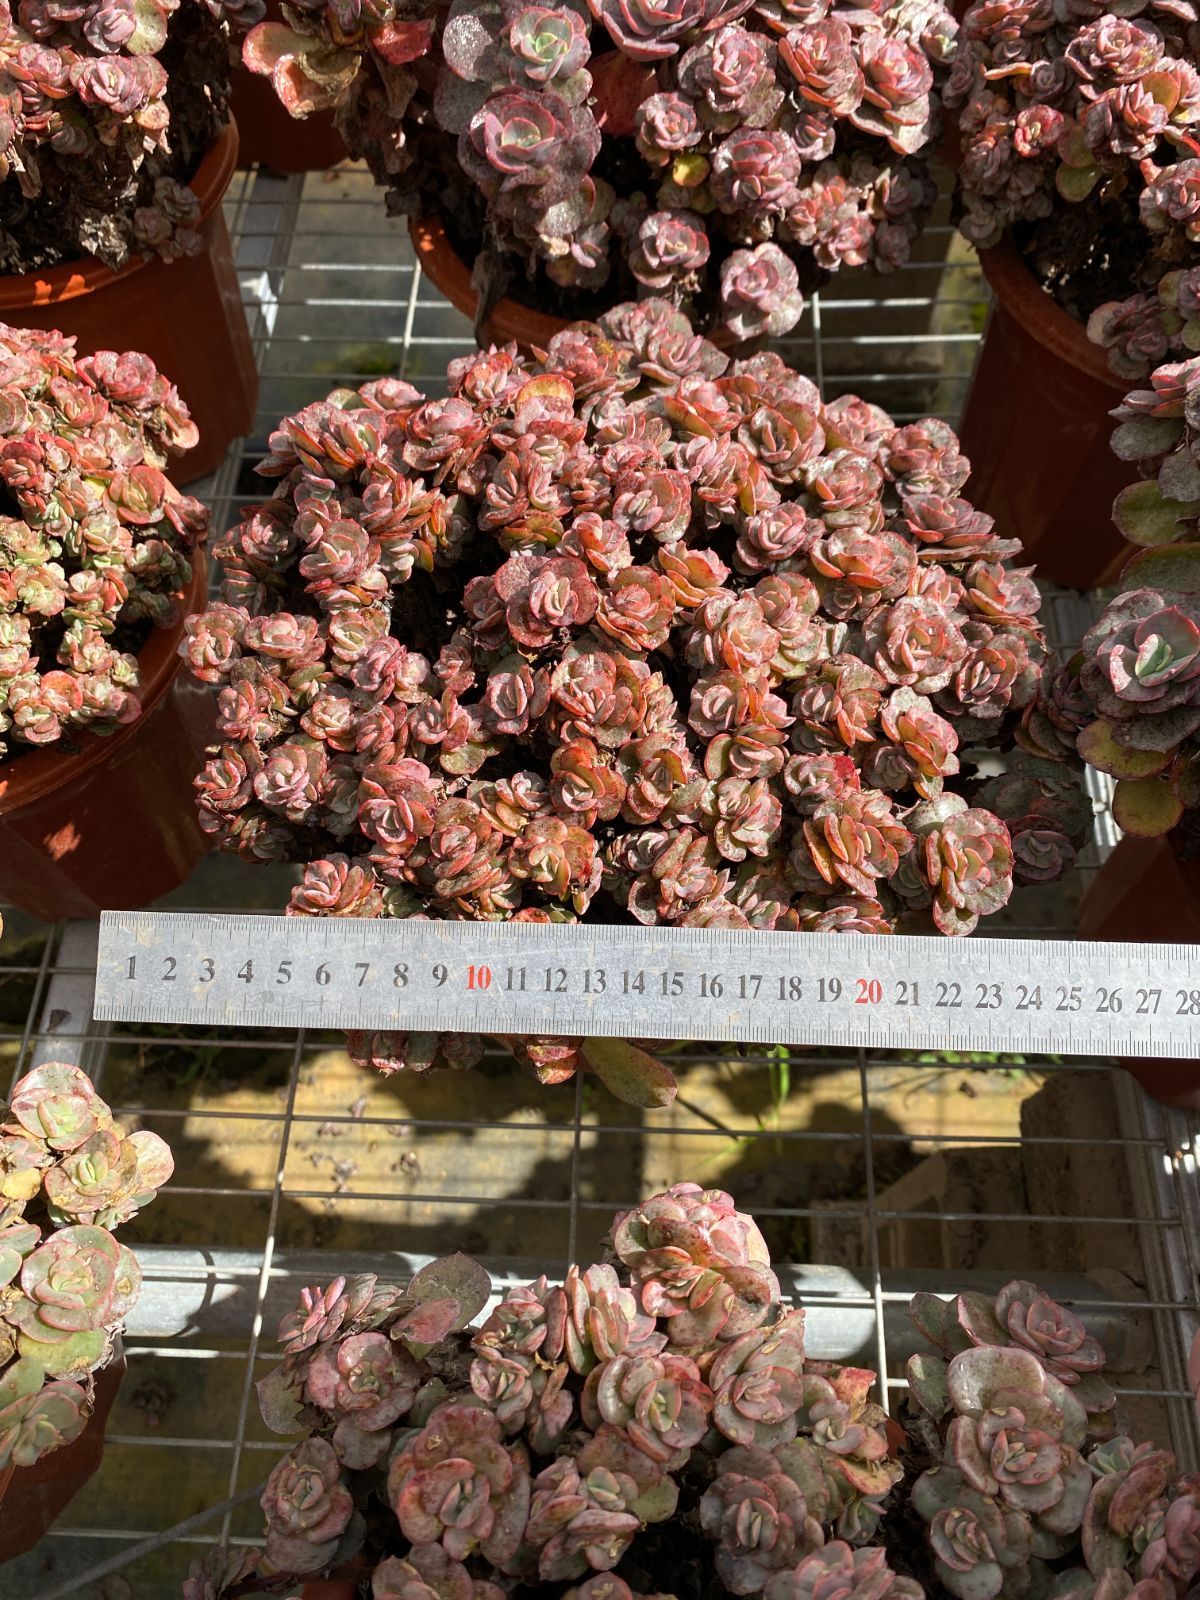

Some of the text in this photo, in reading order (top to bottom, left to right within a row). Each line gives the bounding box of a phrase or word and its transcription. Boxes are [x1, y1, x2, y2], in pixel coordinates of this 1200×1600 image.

[126, 956, 1200, 1015] 1 2 3 4 5 6 7 8 9 10 11 12 13 14 15 16 17 18 19 20 21 22 23 24 25 26 27 28
